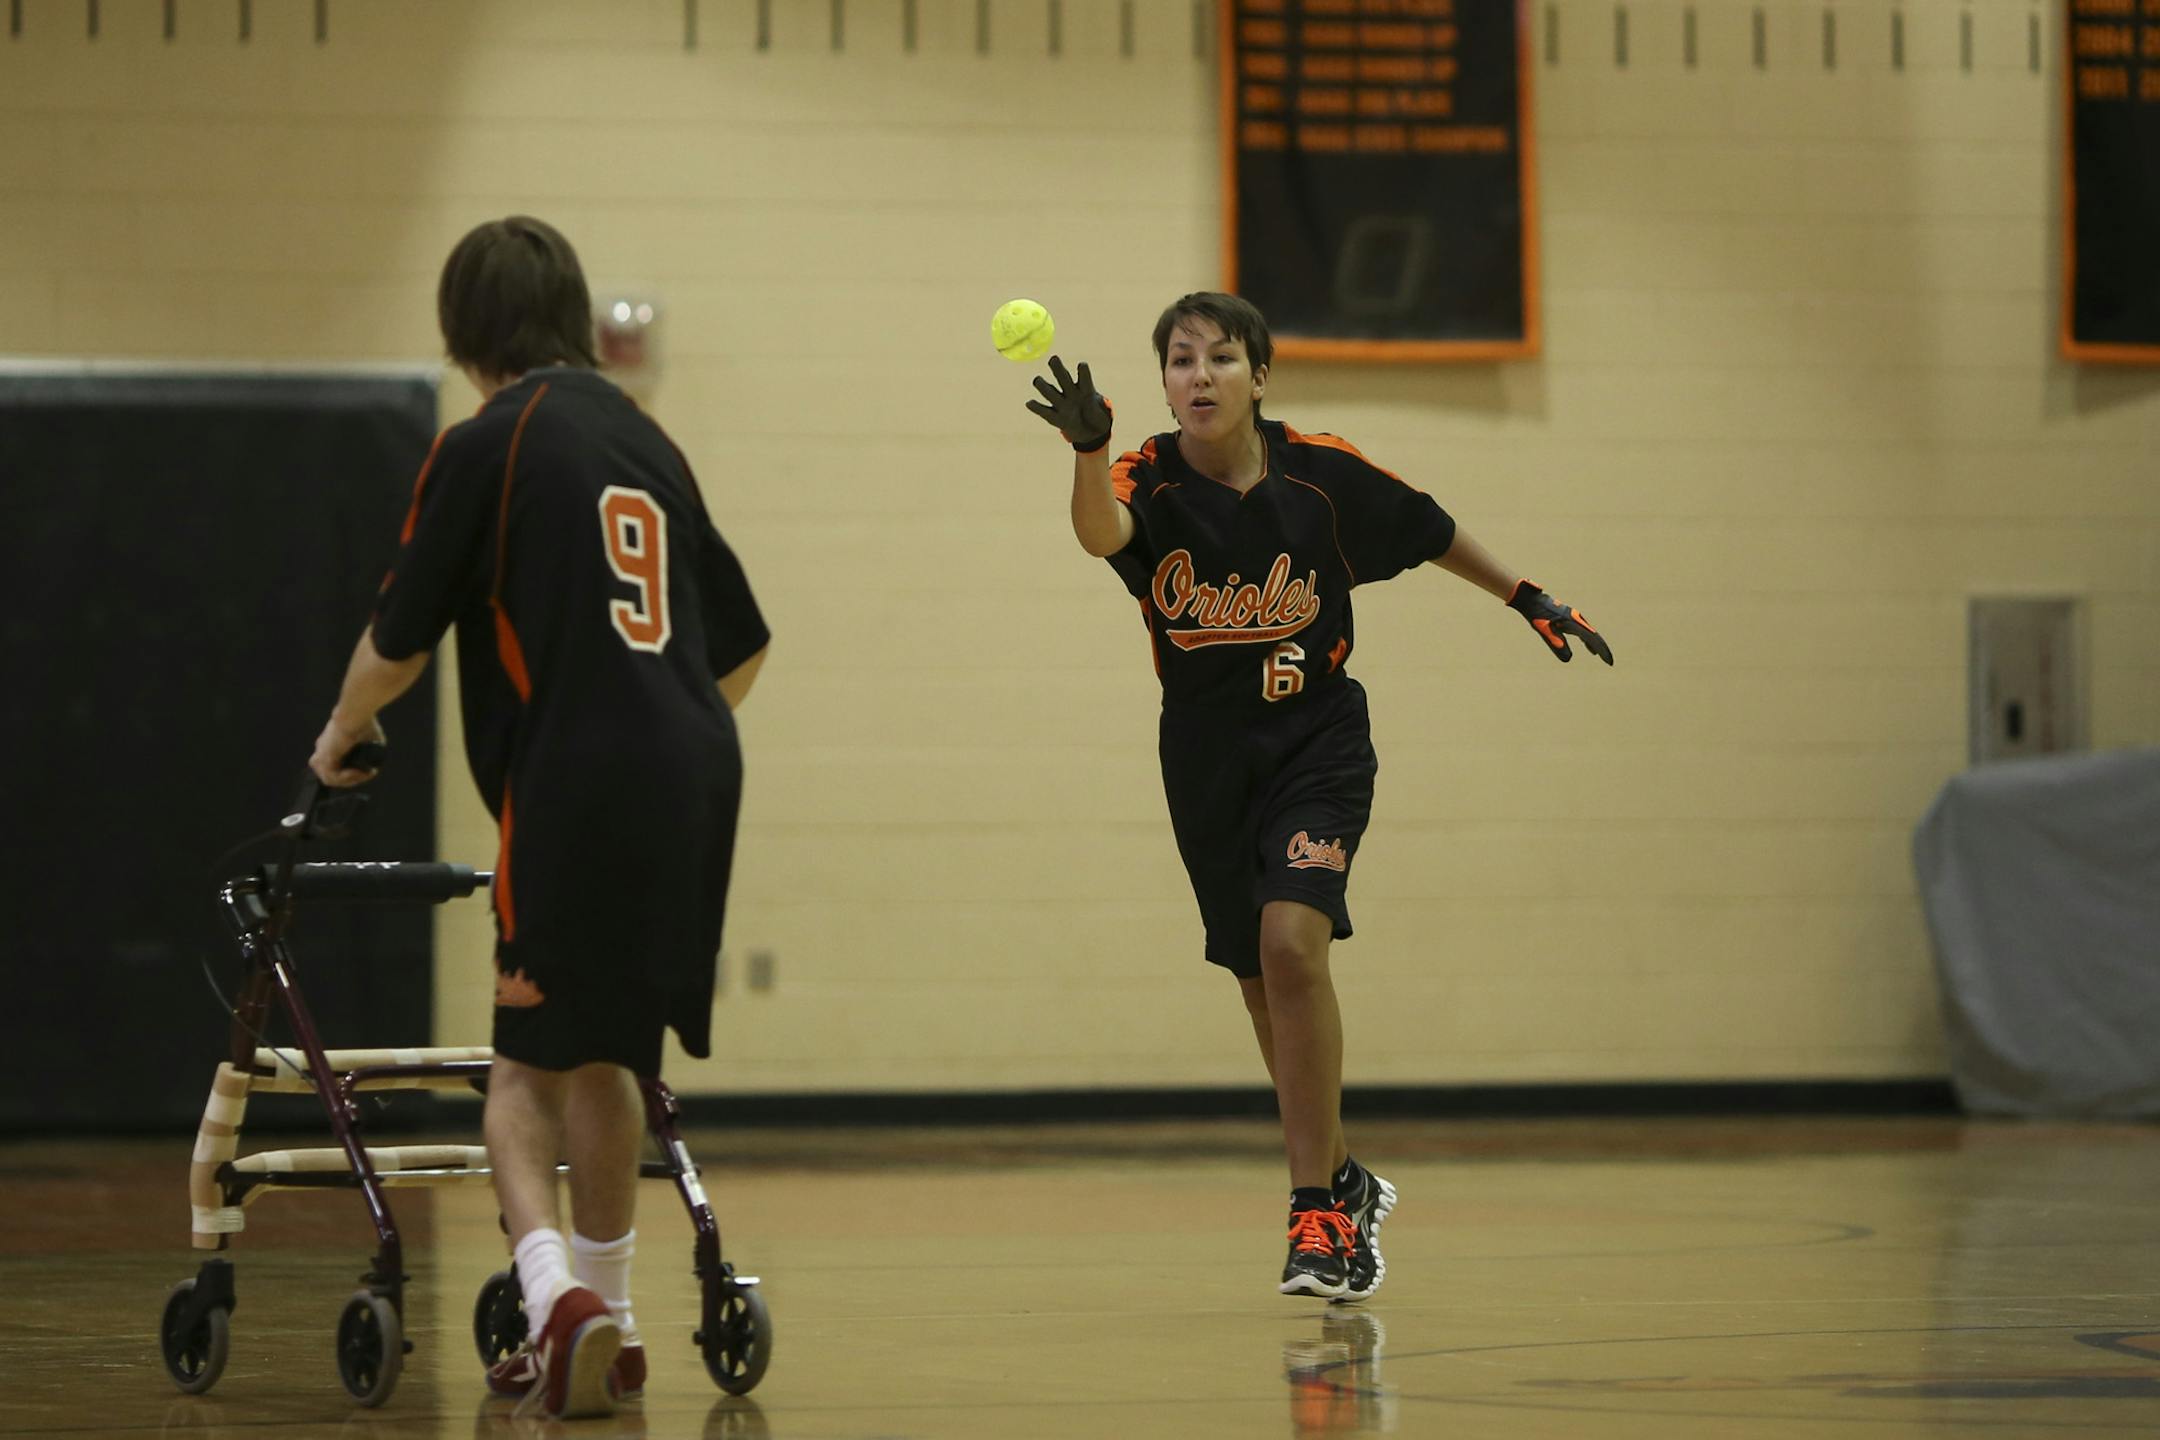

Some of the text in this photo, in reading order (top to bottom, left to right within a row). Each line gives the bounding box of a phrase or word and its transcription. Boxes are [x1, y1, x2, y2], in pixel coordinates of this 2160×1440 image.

[598, 485, 672, 654] 9
[1152, 549, 1320, 627] Orioles
[1262, 641, 1305, 702] 6
